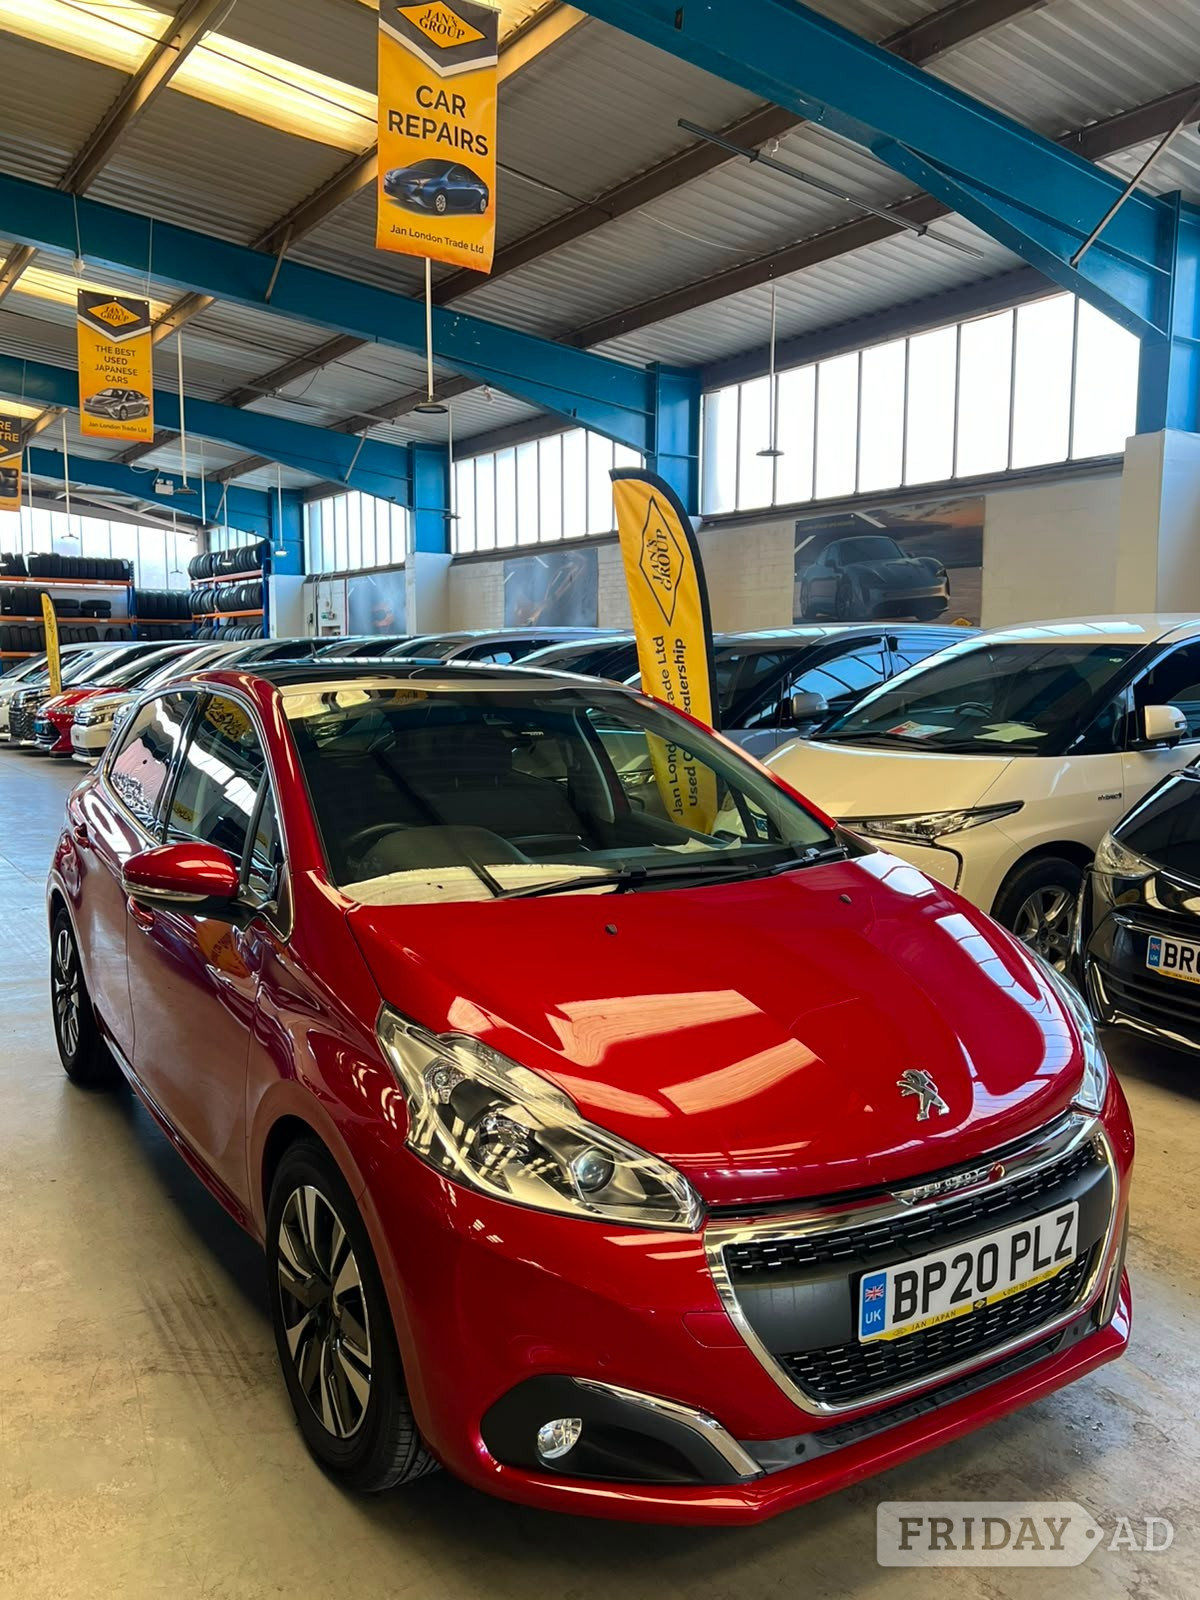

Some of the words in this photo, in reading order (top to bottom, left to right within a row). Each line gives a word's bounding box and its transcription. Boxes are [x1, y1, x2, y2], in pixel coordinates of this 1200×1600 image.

[419, 17, 465, 39] GROUP
[424, 9, 458, 28] JAN'S
[416, 85, 466, 119] CAR
[388, 109, 489, 156] REPAIRS
[390, 224, 407, 236] Jan
[409, 227, 443, 244] London
[444, 237, 469, 250] Trade
[470, 243, 485, 254] Ltd
[100, 311, 129, 323] GROUP
[95, 344, 113, 354] THE
[115, 347, 136, 357] BEST
[104, 355, 128, 366] USED
[95, 364, 138, 376] JAPANESE
[105, 374, 129, 385] CARS
[656, 528, 673, 592] GROUP
[652, 635, 667, 665] Ltd
[672, 638, 692, 714] ealership
[684, 766, 698, 806] Used
[672, 788, 684, 816] Jan
[892, 1243, 999, 1324] BP20
[1009, 1211, 1074, 1281] PLZ
[865, 1309, 882, 1324] UK
[911, 1320, 927, 1332] JAN
[931, 1310, 957, 1324] JAPAN
